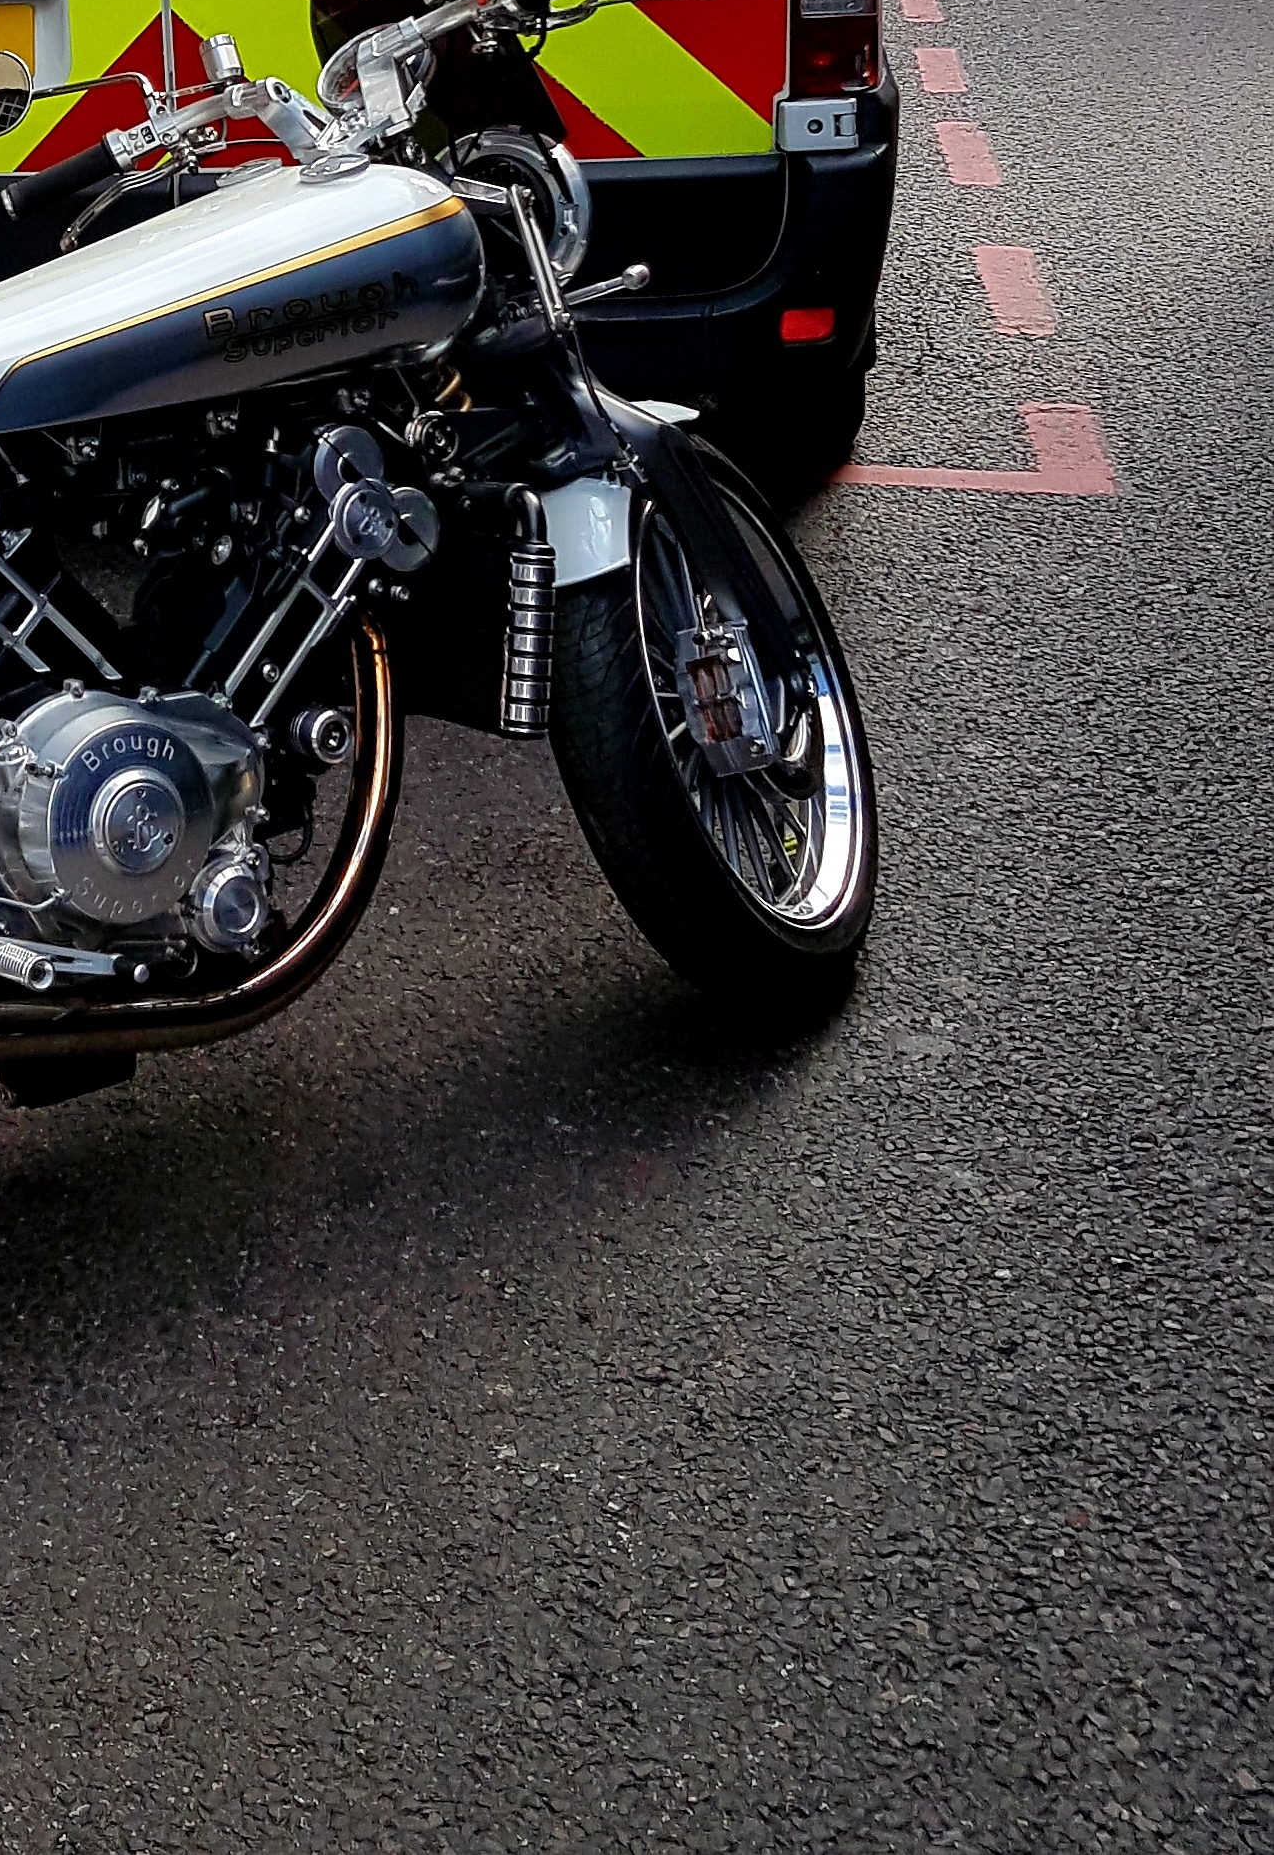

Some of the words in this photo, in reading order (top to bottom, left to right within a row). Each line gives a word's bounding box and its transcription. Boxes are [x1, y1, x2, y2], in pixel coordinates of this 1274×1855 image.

[202, 268, 420, 339] Brough
[223, 309, 400, 363] Superior
[80, 734, 176, 773] Brough
